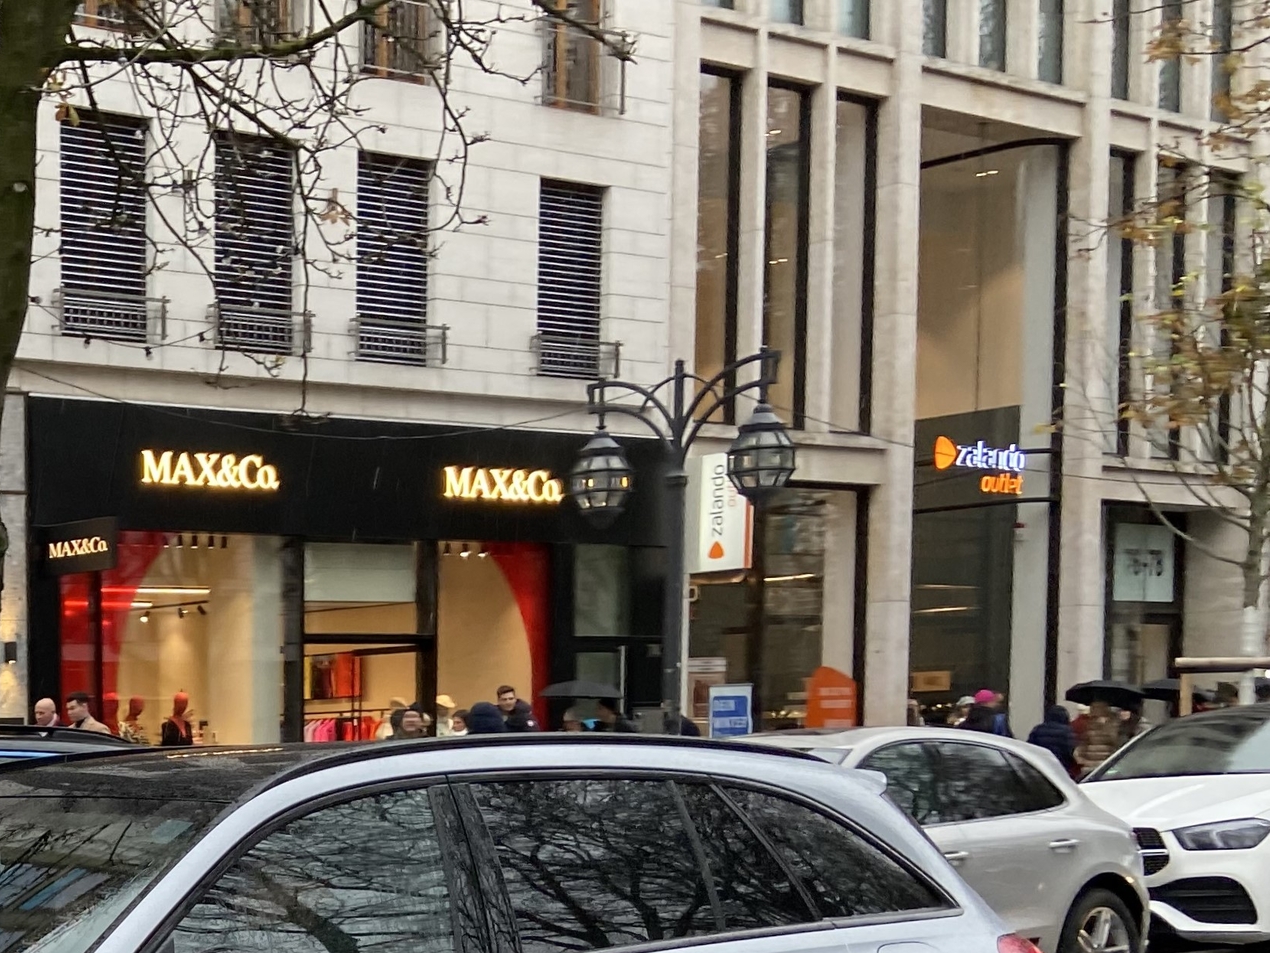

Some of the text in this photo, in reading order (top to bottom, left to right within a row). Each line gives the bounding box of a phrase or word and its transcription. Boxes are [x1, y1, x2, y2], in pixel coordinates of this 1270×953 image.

[141, 449, 281, 490] MAX&Co.
[955, 440, 1025, 472] zalando
[443, 465, 566, 503] MAX&Co.
[710, 464, 725, 537] zalando
[980, 472, 1024, 495] outlet
